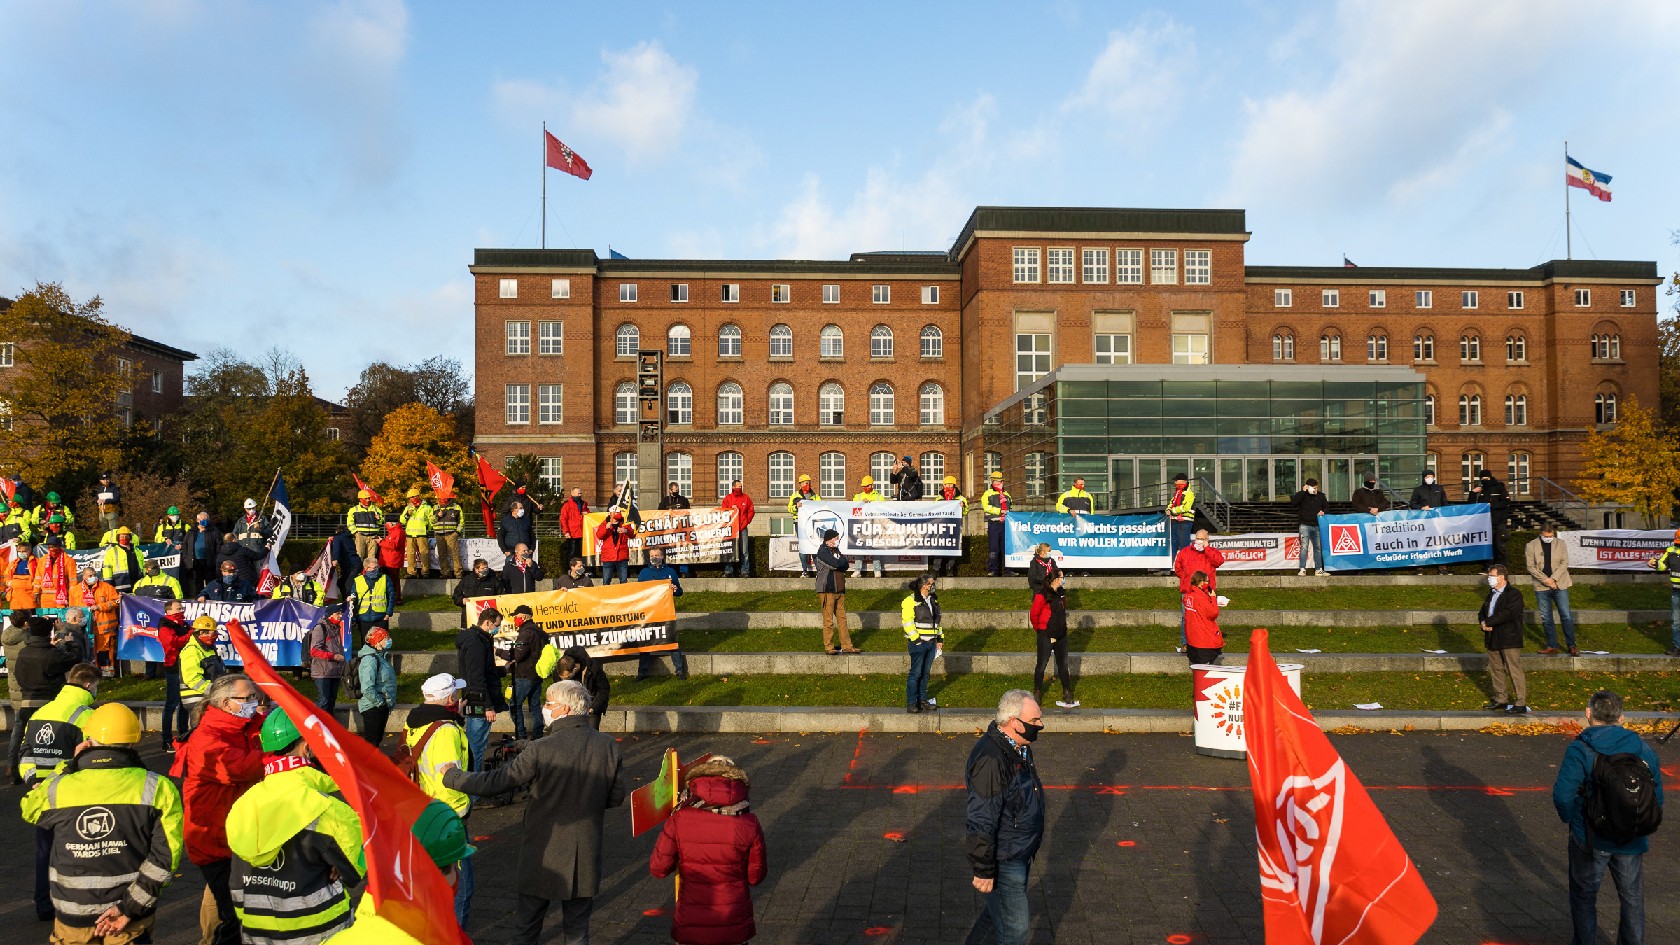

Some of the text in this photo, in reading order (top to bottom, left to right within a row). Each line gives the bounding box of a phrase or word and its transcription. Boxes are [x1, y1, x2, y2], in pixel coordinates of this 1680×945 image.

[639, 511, 731, 532] SCHÄFTIGUNG
[852, 522, 957, 535] FÜR ZUKUNFT
[1011, 522, 1031, 532] Viel
[1033, 522, 1075, 534] geredet
[1083, 522, 1118, 534] Nichts
[1118, 522, 1166, 535] passiert!
[1372, 522, 1426, 534] Tradition
[646, 532, 686, 546] ZUKUNFT
[689, 525, 732, 541] SICHERN!
[855, 536, 957, 547] & BESCHÄFTIGUNG!
[1375, 530, 1488, 551] auch in ZUKUNFT!
[1058, 537, 1167, 547] WIR WOLLEN ZUKUNFT!
[1582, 538, 1604, 547] WENN
[1605, 539, 1621, 547] WIR
[1226, 550, 1264, 560] MÖGLICH
[1376, 549, 1463, 562] Gebrüder Friedrich Werft
[1599, 550, 1663, 560] IST ALLES MÖG
[182, 603, 257, 622] EMEINSAM
[546, 619, 565, 630] UND
[566, 612, 646, 628] VERANTWORTUNG
[559, 634, 574, 648] IN
[576, 633, 599, 647] DIE
[600, 626, 667, 645] ZUKUNFT!
[1228, 701, 1242, 711] #F
[33, 747, 63, 755] ssenkrupp
[65, 841, 100, 851] GERMAN
[71, 847, 121, 858] YARDS KIEL
